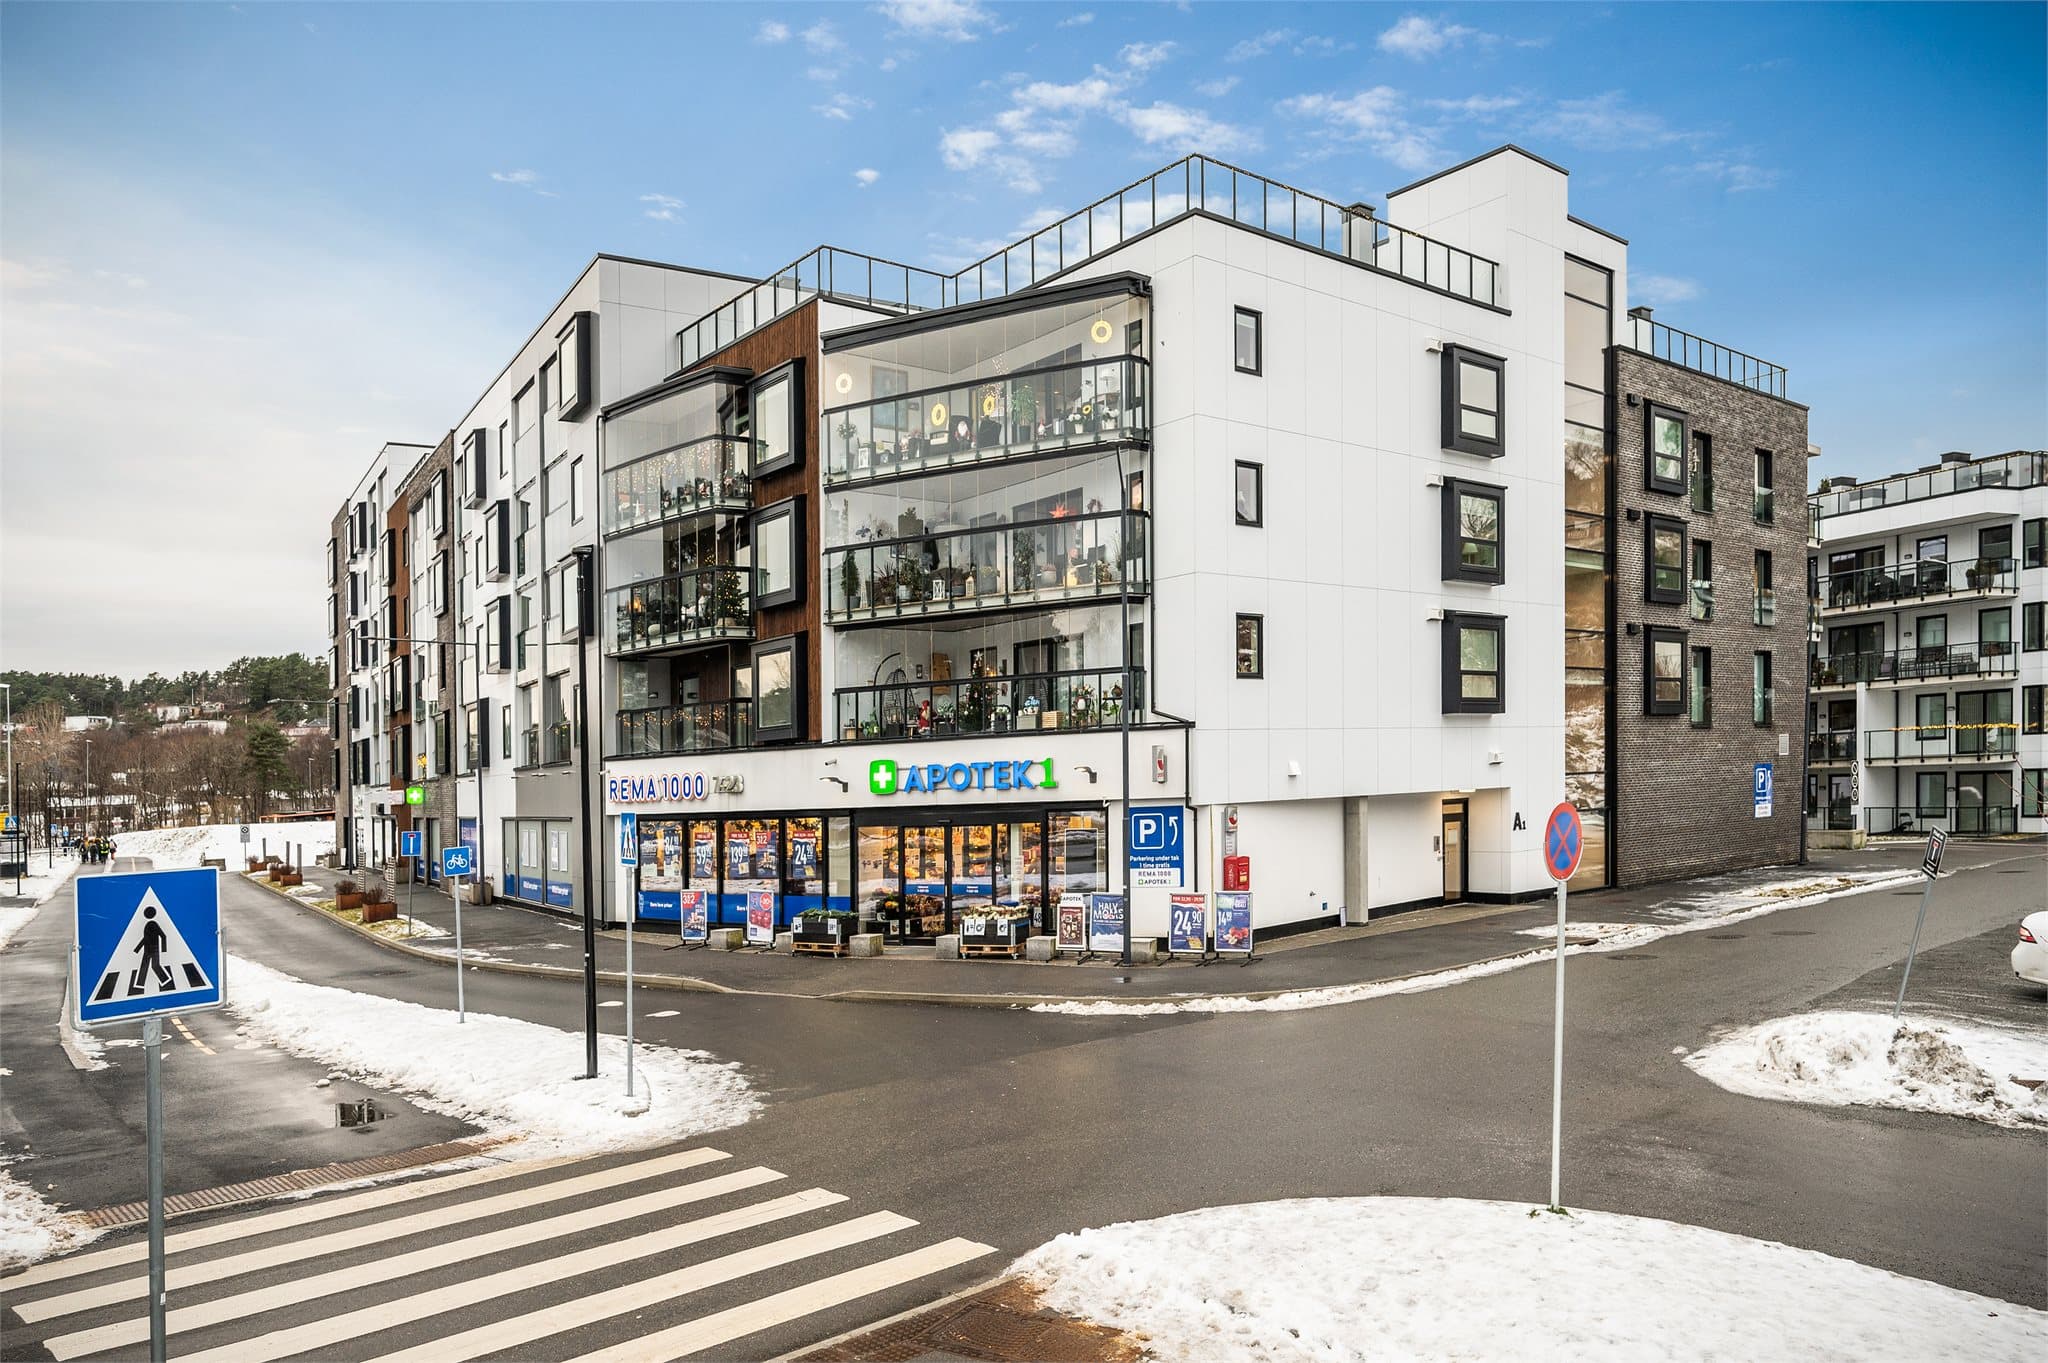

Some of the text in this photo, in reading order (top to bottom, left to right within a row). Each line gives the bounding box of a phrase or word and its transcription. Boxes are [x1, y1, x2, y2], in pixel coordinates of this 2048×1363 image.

[903, 757, 1058, 794] APOTEK 1
[1758, 770, 1765, 789] P
[609, 777, 657, 801] REMA
[661, 774, 705, 799] 1000
[1139, 818, 1157, 844] P
[1512, 811, 1526, 831] A1
[696, 845, 706, 865] 59
[731, 846, 743, 864] 139
[795, 844, 807, 865] 24
[1174, 910, 1202, 935] 24 90
[1217, 911, 1227, 926] 14
